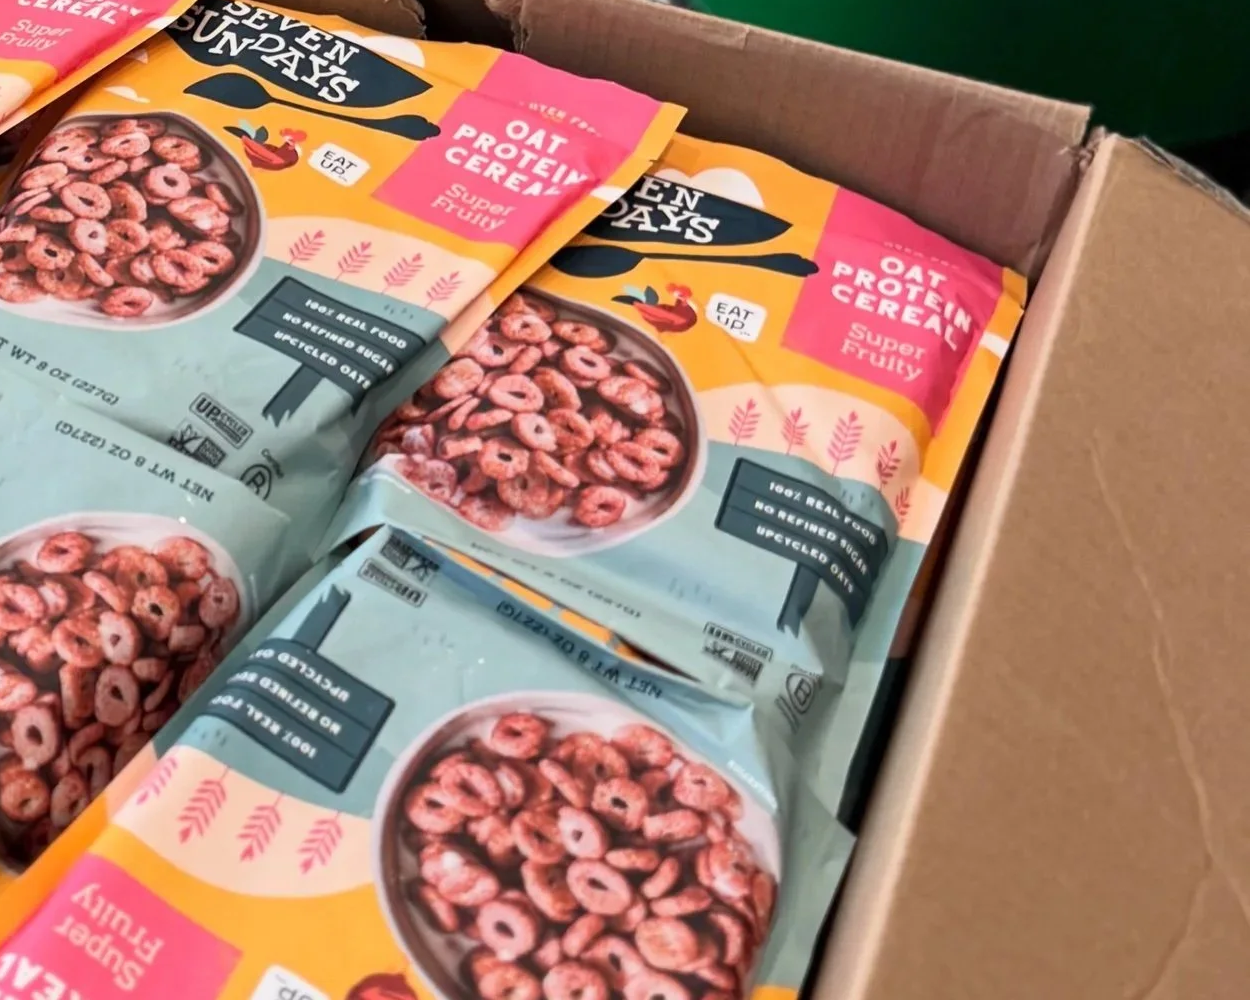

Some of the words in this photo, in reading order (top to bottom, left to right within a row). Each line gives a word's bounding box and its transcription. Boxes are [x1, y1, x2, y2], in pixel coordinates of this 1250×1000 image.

[11, 18, 74, 38] Super
[222, 0, 360, 66] SEVEN
[452, 123, 589, 186] PROTEIN
[505, 119, 569, 155] OAT
[323, 149, 359, 170] EAT
[431, 195, 506, 233] Fruity
[444, 182, 518, 217] Super
[880, 255, 948, 290] OAT
[716, 302, 755, 321] EAT
[831, 260, 973, 334] PROTEIN
[304, 298, 335, 318] 100%
[335, 311, 368, 332] REAL
[369, 324, 408, 351] FOOD
[831, 283, 958, 352] CEREAL
[282, 311, 302, 325] NO
[302, 320, 356, 350] REFINED
[355, 344, 395, 377] SUGAR
[847, 321, 927, 361] Super
[10, 344, 37, 366] WT
[36, 360, 49, 372] 8
[49, 367, 72, 384] OZ
[72, 377, 120, 406] (227G)
[273, 330, 339, 367] UPCYCLED
[339, 363, 372, 391] OATS
[840, 338, 924, 383] Fruity
[54, 420, 107, 450] (227G)
[108, 443, 132, 461] OZ
[134, 455, 147, 468] 8
[148, 462, 176, 484] WT
[179, 477, 215, 503] NET
[769, 480, 802, 502] 100%
[805, 495, 840, 520] REAL
[844, 514, 878, 546] FOOD
[754, 499, 775, 515] NO
[777, 508, 838, 543] REFINED
[839, 537, 869, 576] SUGAR
[756, 524, 829, 565] UPCYCLED
[830, 562, 854, 594] OATS
[552, 634, 575, 654] OZ
[277, 651, 350, 703] UPCYCLED
[591, 661, 620, 684] WT
[624, 676, 663, 699] NET
[259, 676, 320, 721] REFINED
[246, 702, 282, 736] REAL
[318, 715, 343, 736] NO
[281, 730, 318, 760] 100%
[70, 882, 165, 966] Fruity
[52, 914, 146, 993] Super
